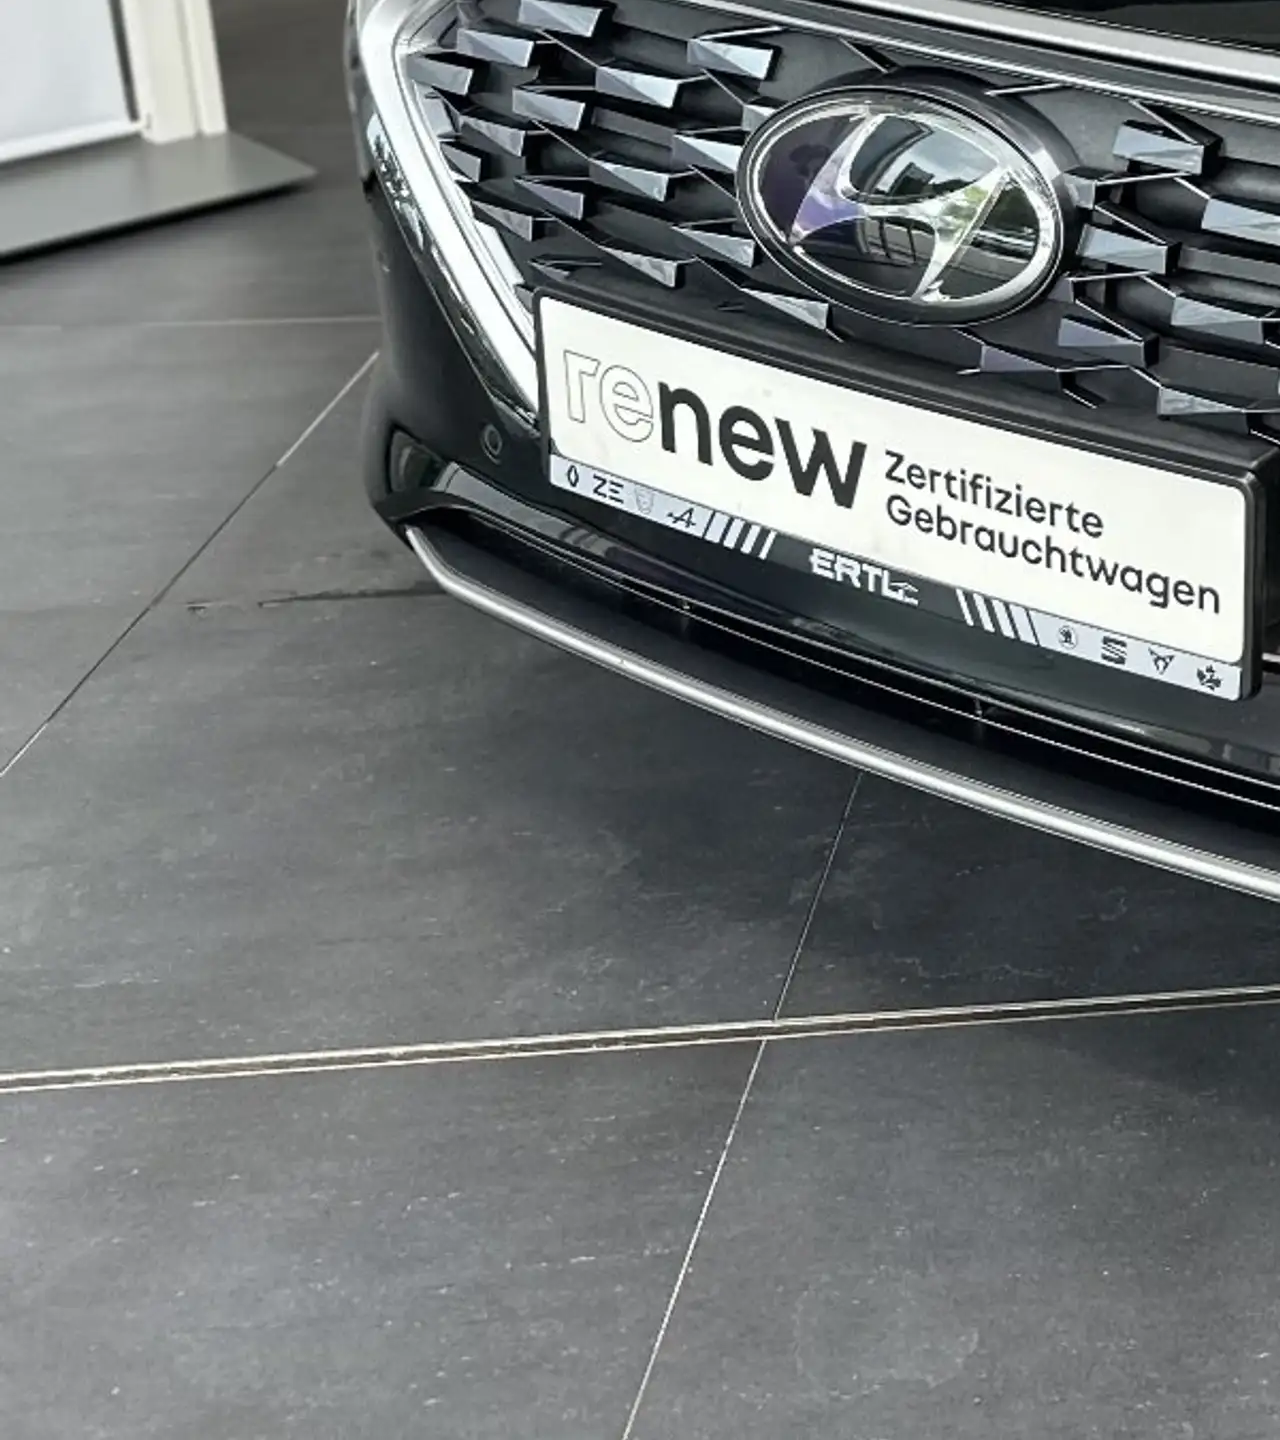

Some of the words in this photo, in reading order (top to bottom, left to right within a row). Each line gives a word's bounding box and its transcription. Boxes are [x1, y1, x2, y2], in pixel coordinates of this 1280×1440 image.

[563, 348, 868, 510] renew
[885, 448, 1104, 539] Zertifizierte
[809, 546, 907, 602] ERTL
[886, 493, 1221, 614] Gebrauchtwagen
